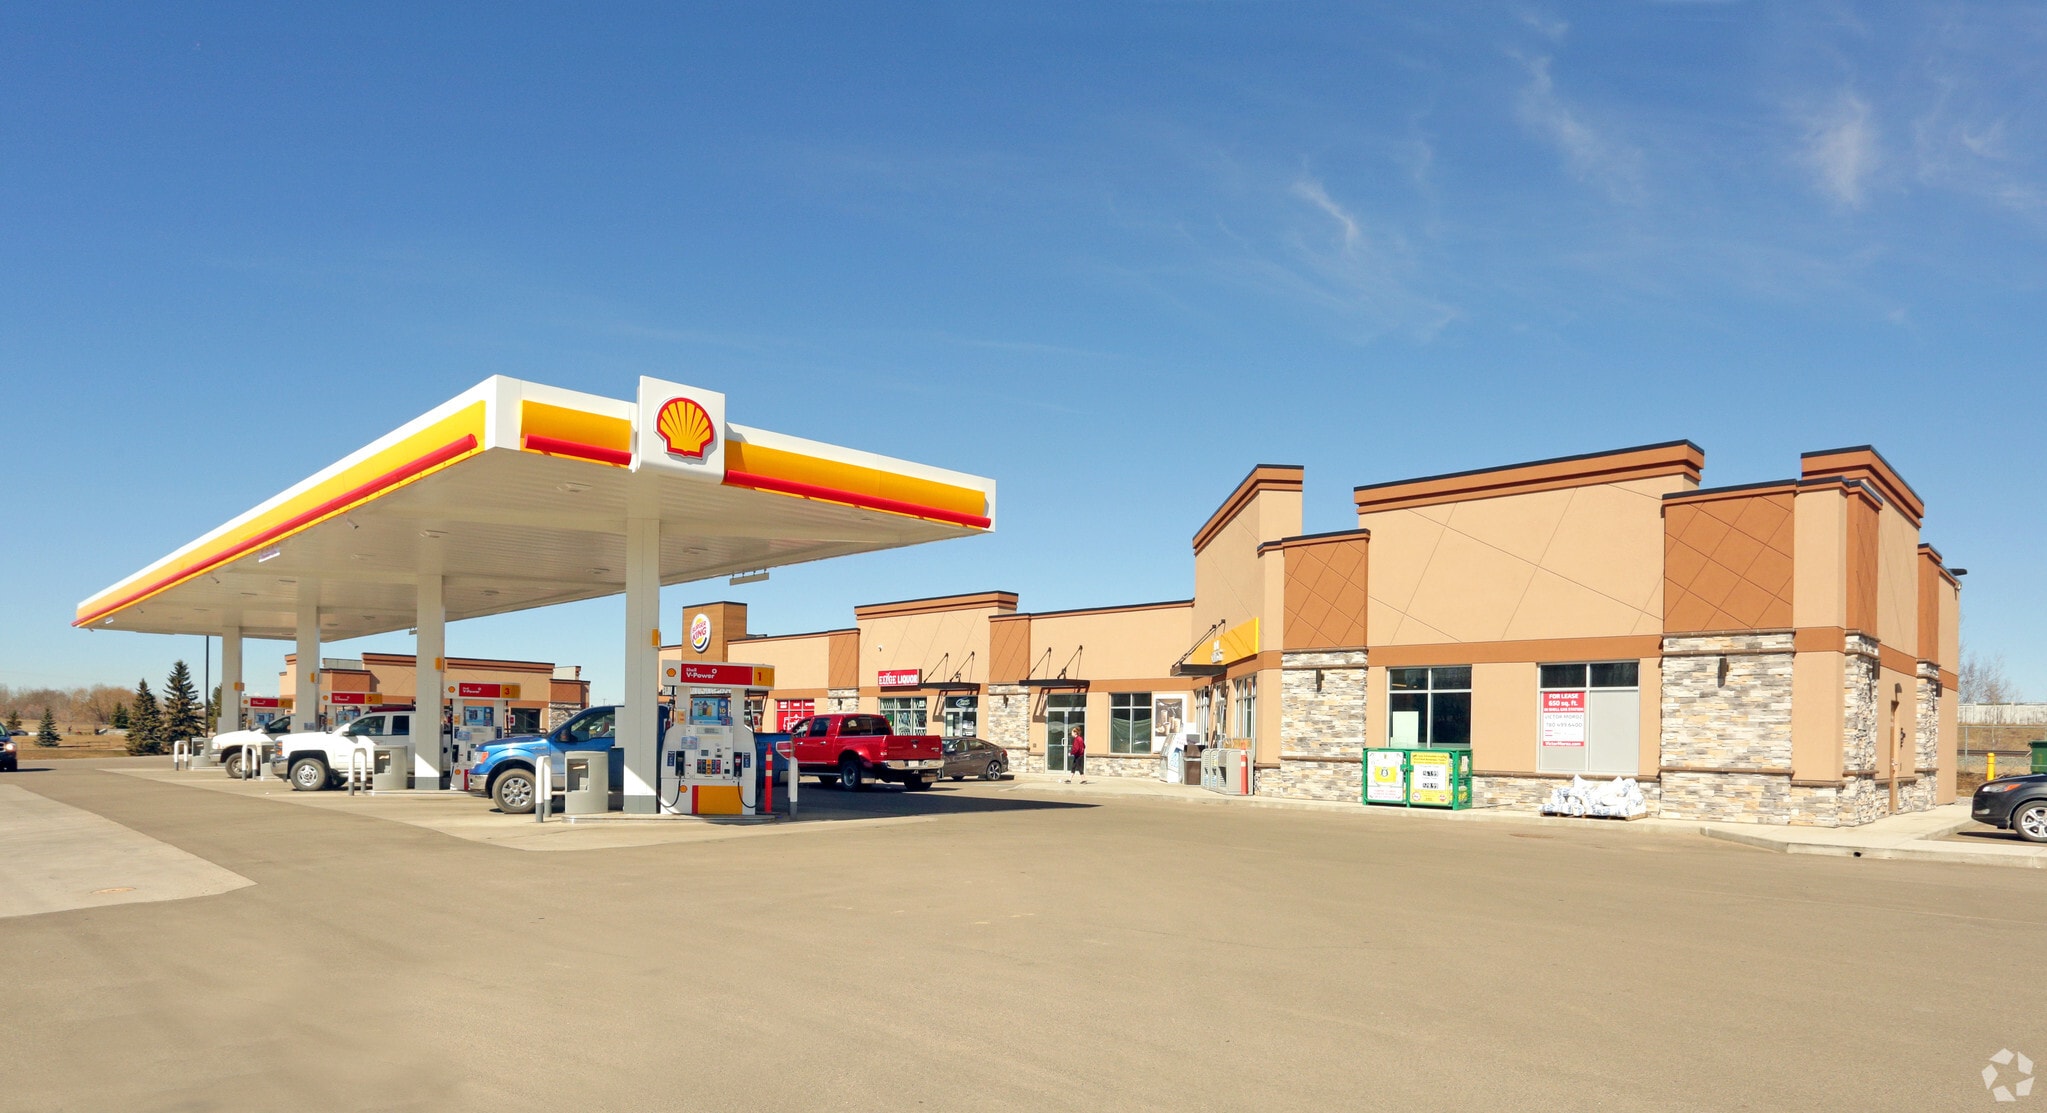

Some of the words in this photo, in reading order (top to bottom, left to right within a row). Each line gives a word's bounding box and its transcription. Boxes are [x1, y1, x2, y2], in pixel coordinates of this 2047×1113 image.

[692, 626, 707, 641] KING
[757, 671, 762, 682] 1
[897, 674, 918, 684] LIQUOR
[504, 687, 510, 695] 3
